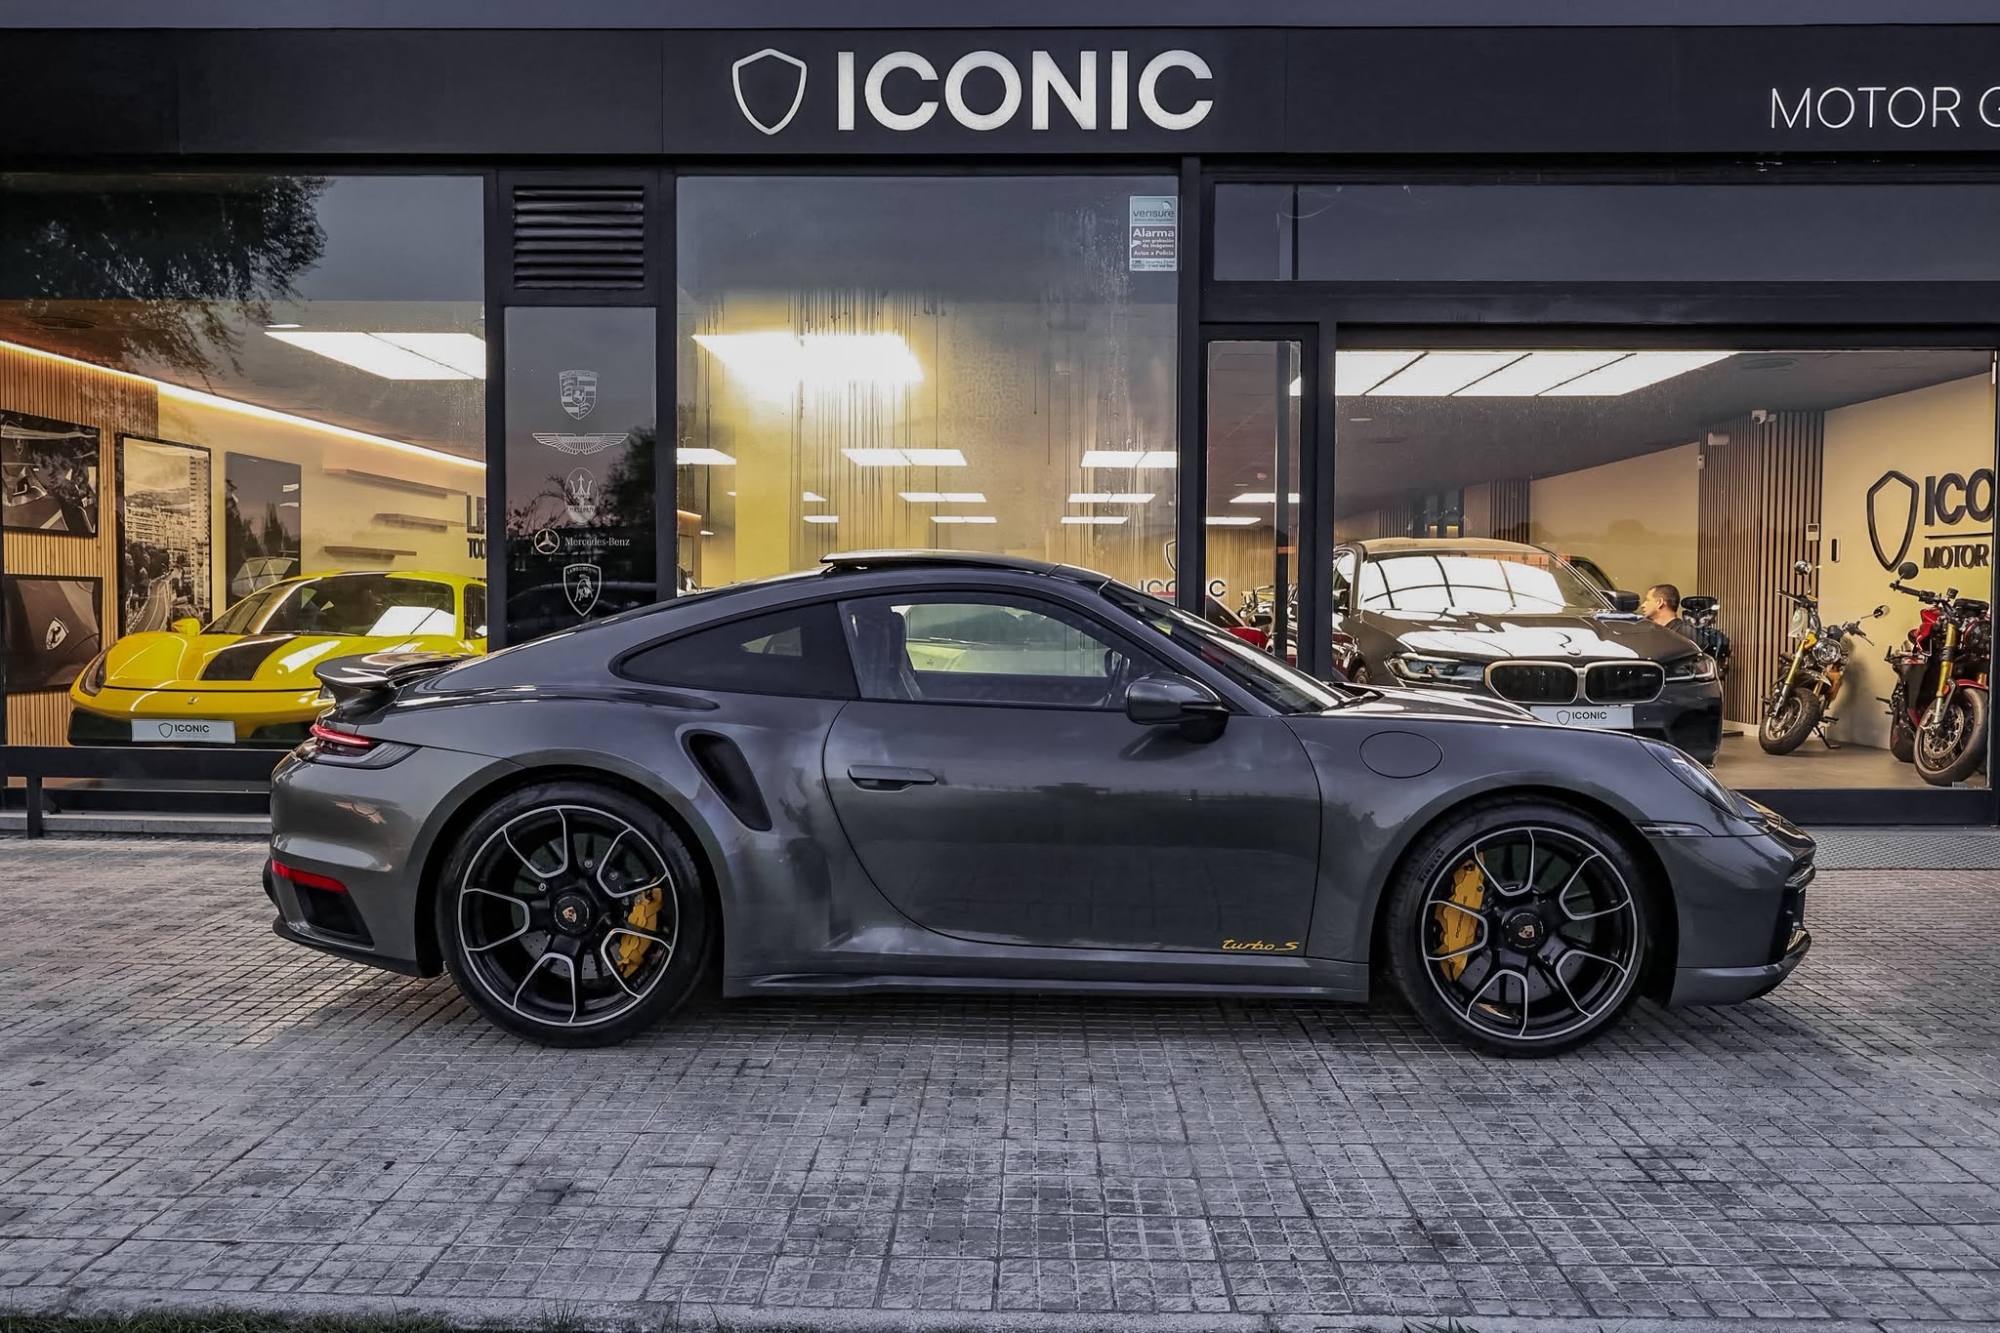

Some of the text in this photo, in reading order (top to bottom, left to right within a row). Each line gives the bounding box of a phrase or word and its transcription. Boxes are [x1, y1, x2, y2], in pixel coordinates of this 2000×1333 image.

[837, 50, 1213, 131] ICONIC
[1770, 86, 1961, 129] MOTOR
[1133, 228, 1174, 237] Alarma
[565, 537, 630, 546] Mercedes-Benz
[1923, 544, 1989, 569] MOTOR
[1572, 711, 1607, 719] ICONIC
[174, 724, 210, 733] ICONIC
[1222, 939, 1275, 950] turbo
